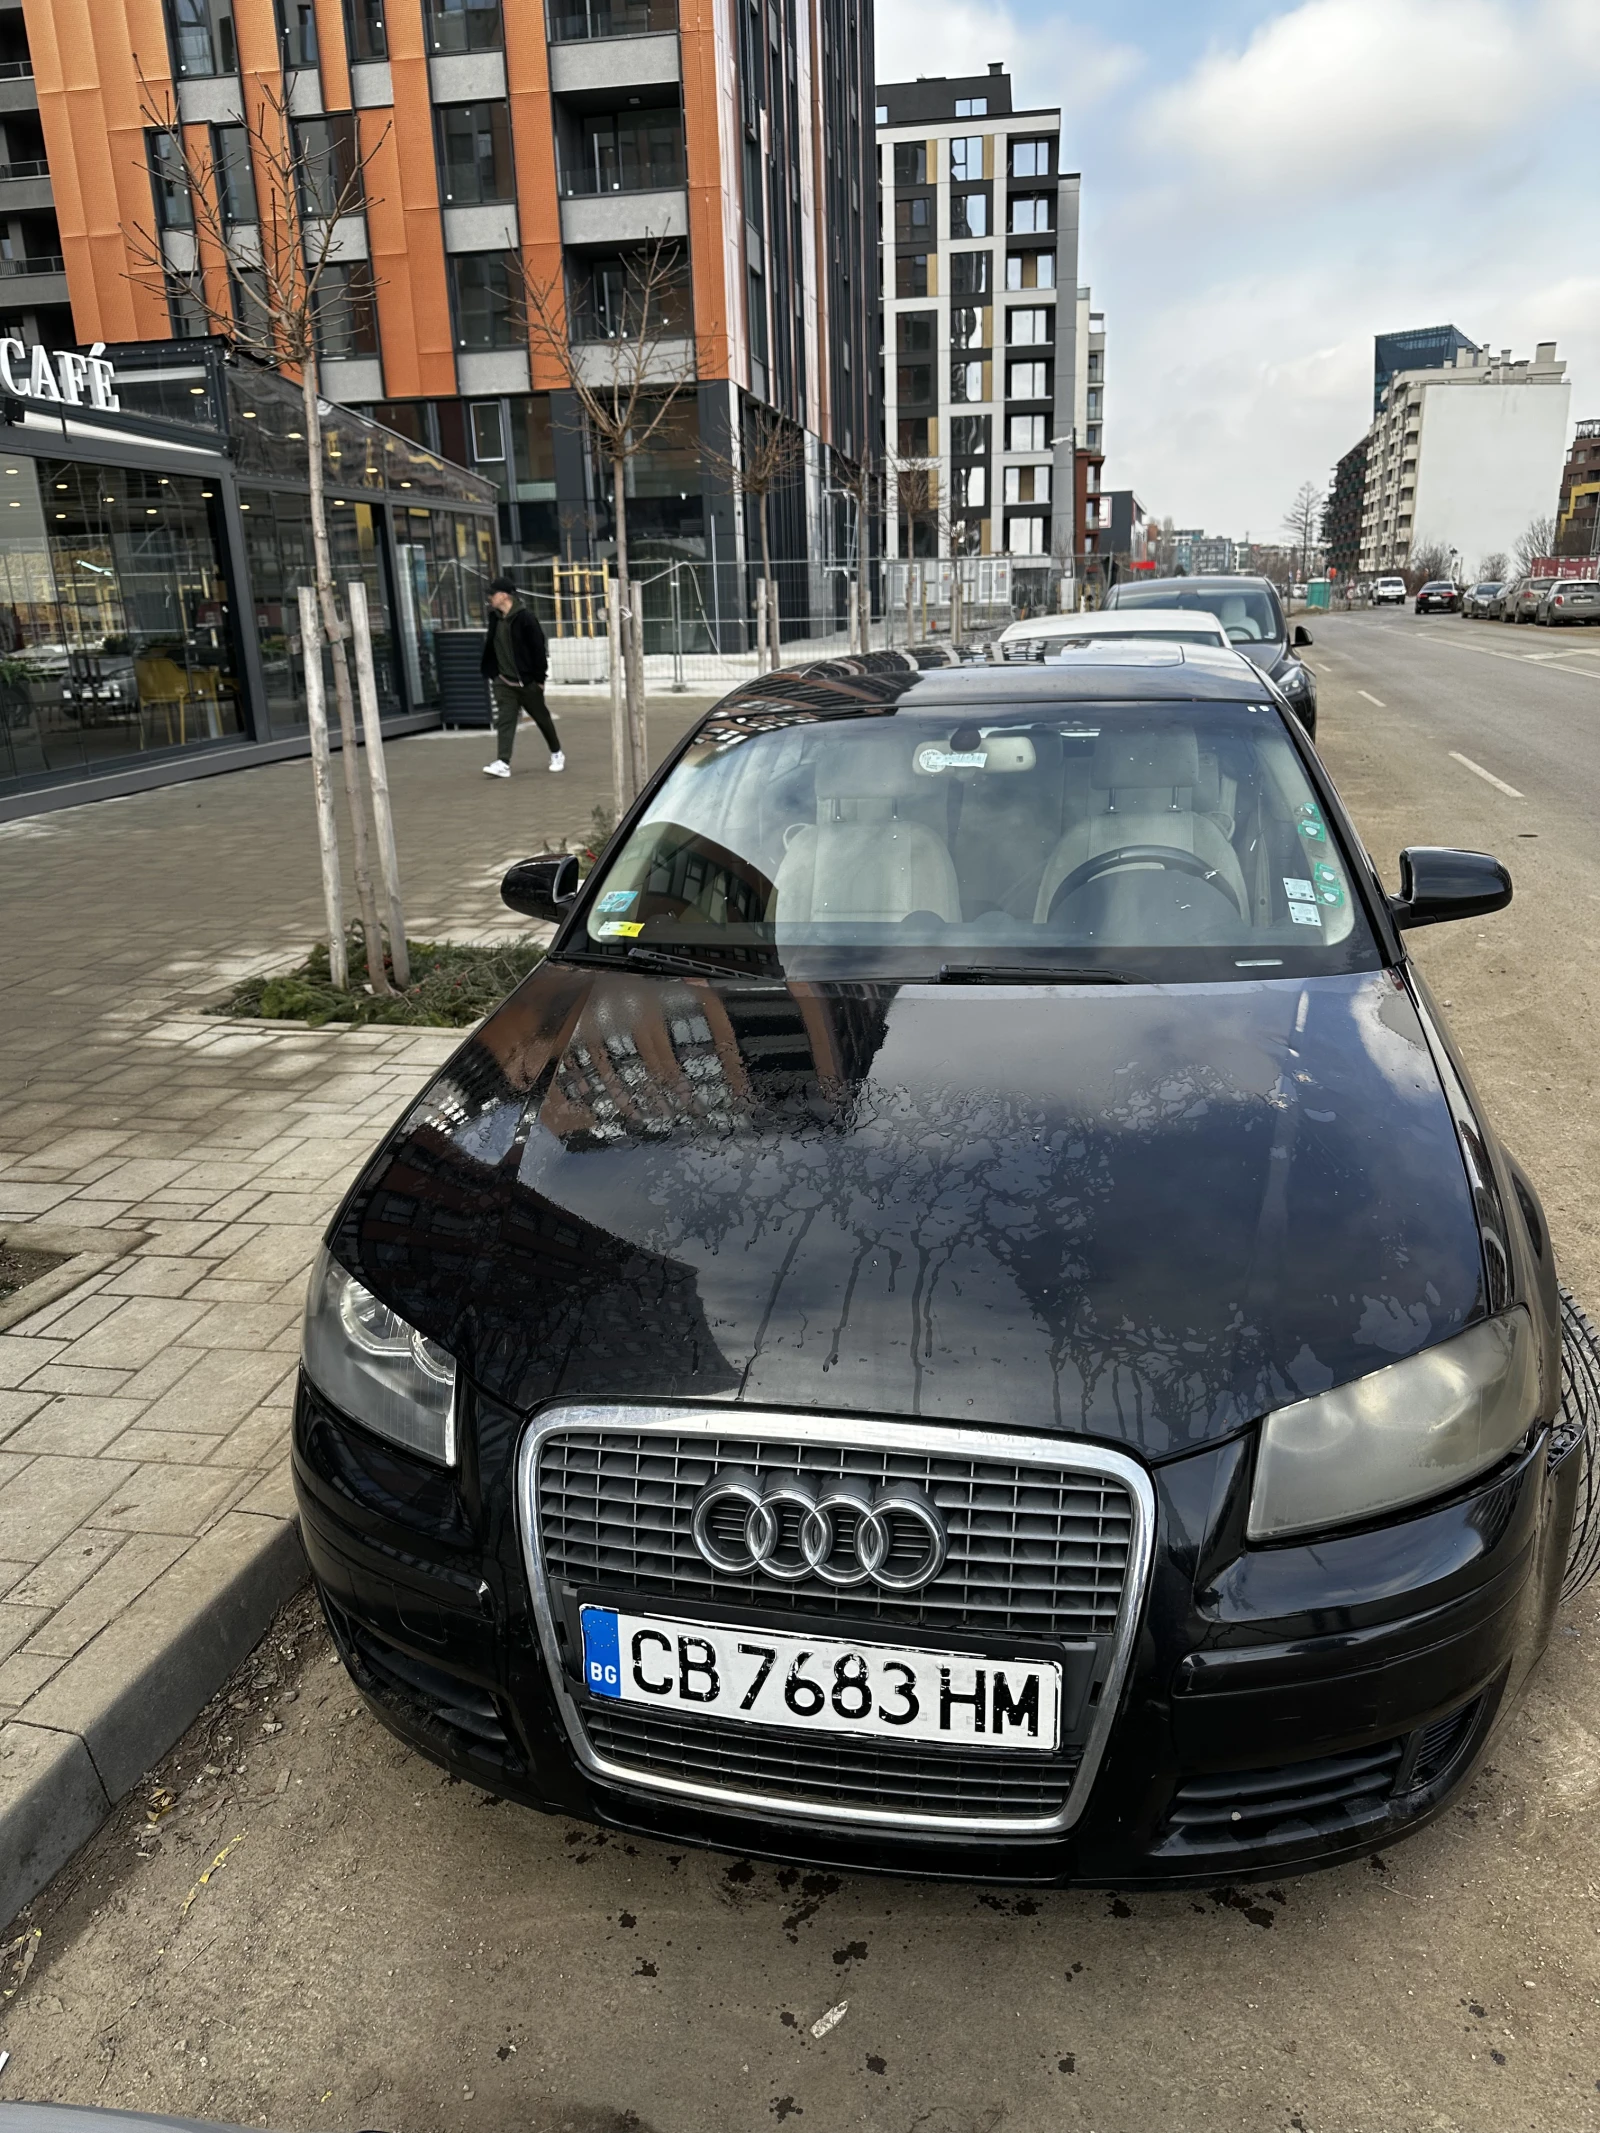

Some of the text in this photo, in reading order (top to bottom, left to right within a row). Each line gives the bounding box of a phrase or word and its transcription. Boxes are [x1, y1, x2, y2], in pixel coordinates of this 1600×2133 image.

[0, 338, 120, 412] CAFÉ
[590, 1661, 617, 1685] BG
[631, 1629, 1040, 1737] CB 7683 HM
